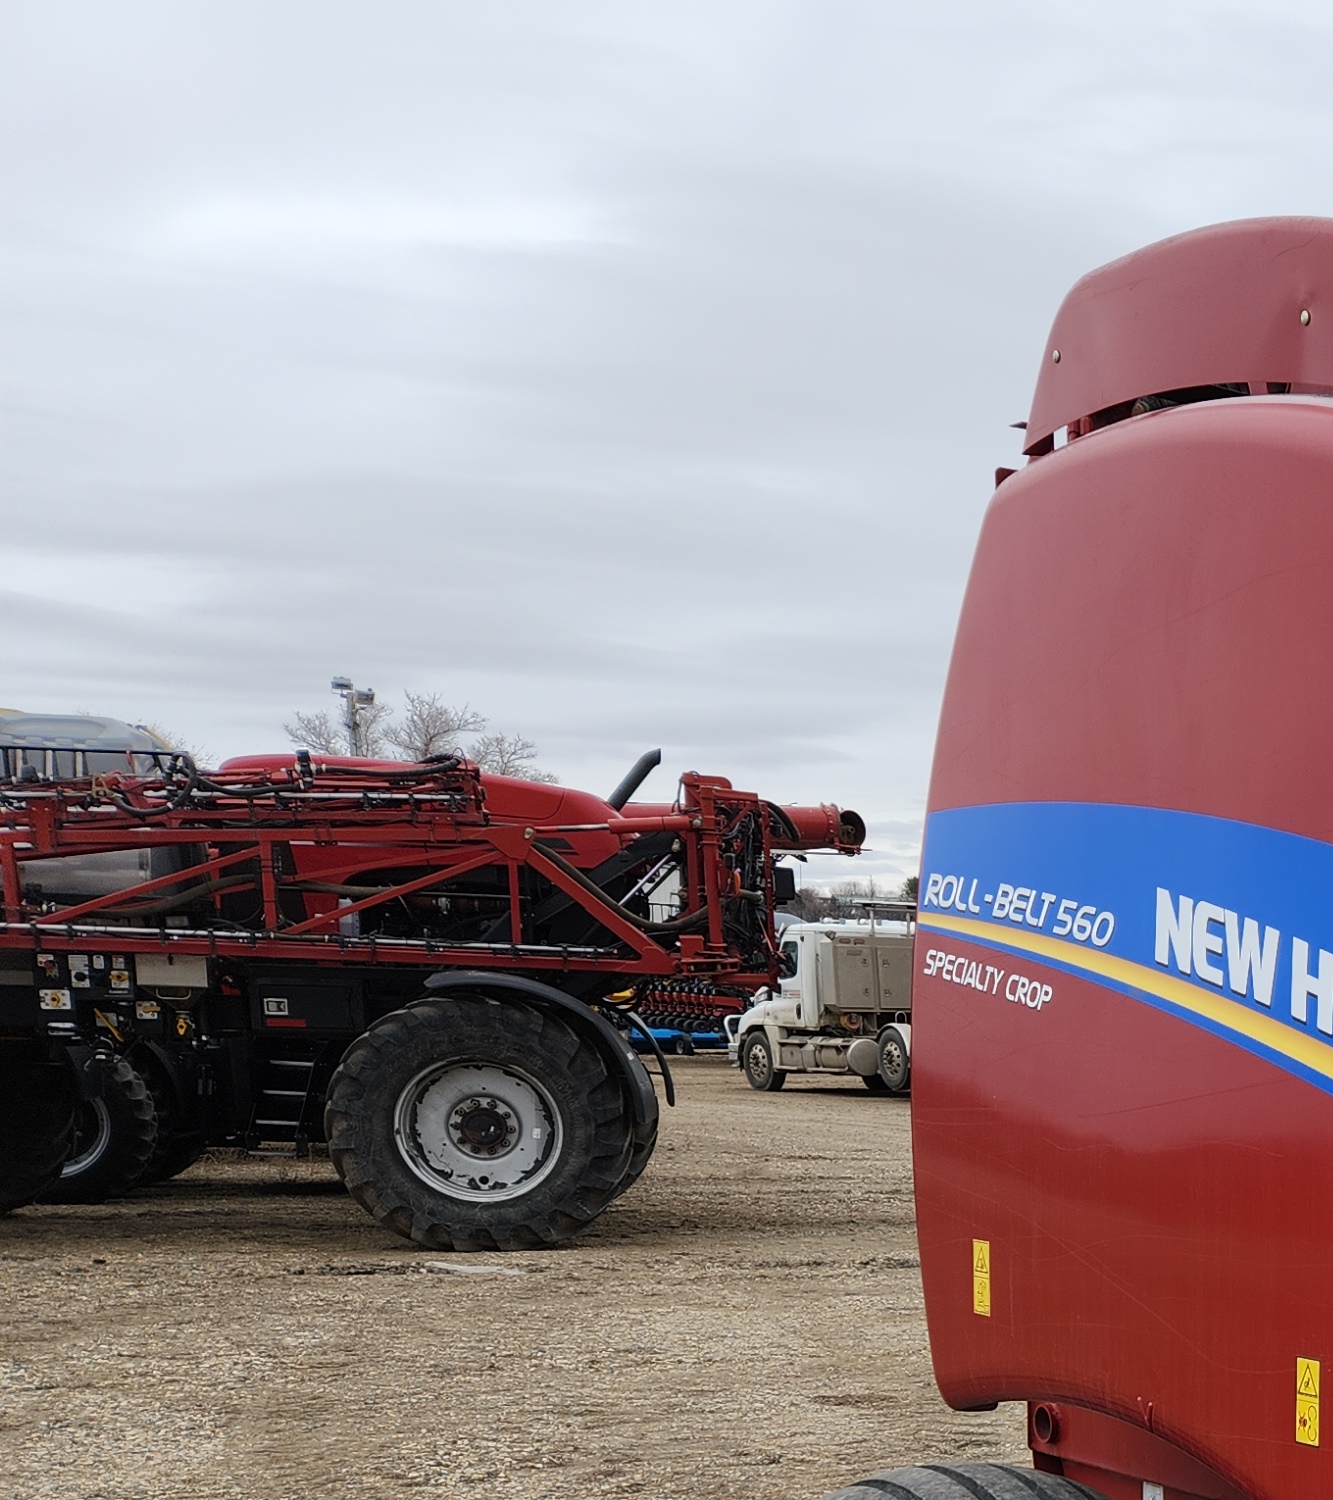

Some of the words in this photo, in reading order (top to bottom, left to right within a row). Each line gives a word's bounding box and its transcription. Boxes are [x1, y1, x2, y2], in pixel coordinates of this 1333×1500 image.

[1052, 898, 1116, 947] 560
[1153, 886, 1281, 1008] NEW
[923, 948, 1005, 996] SPECIALTY
[1005, 973, 1054, 1011] CROP
